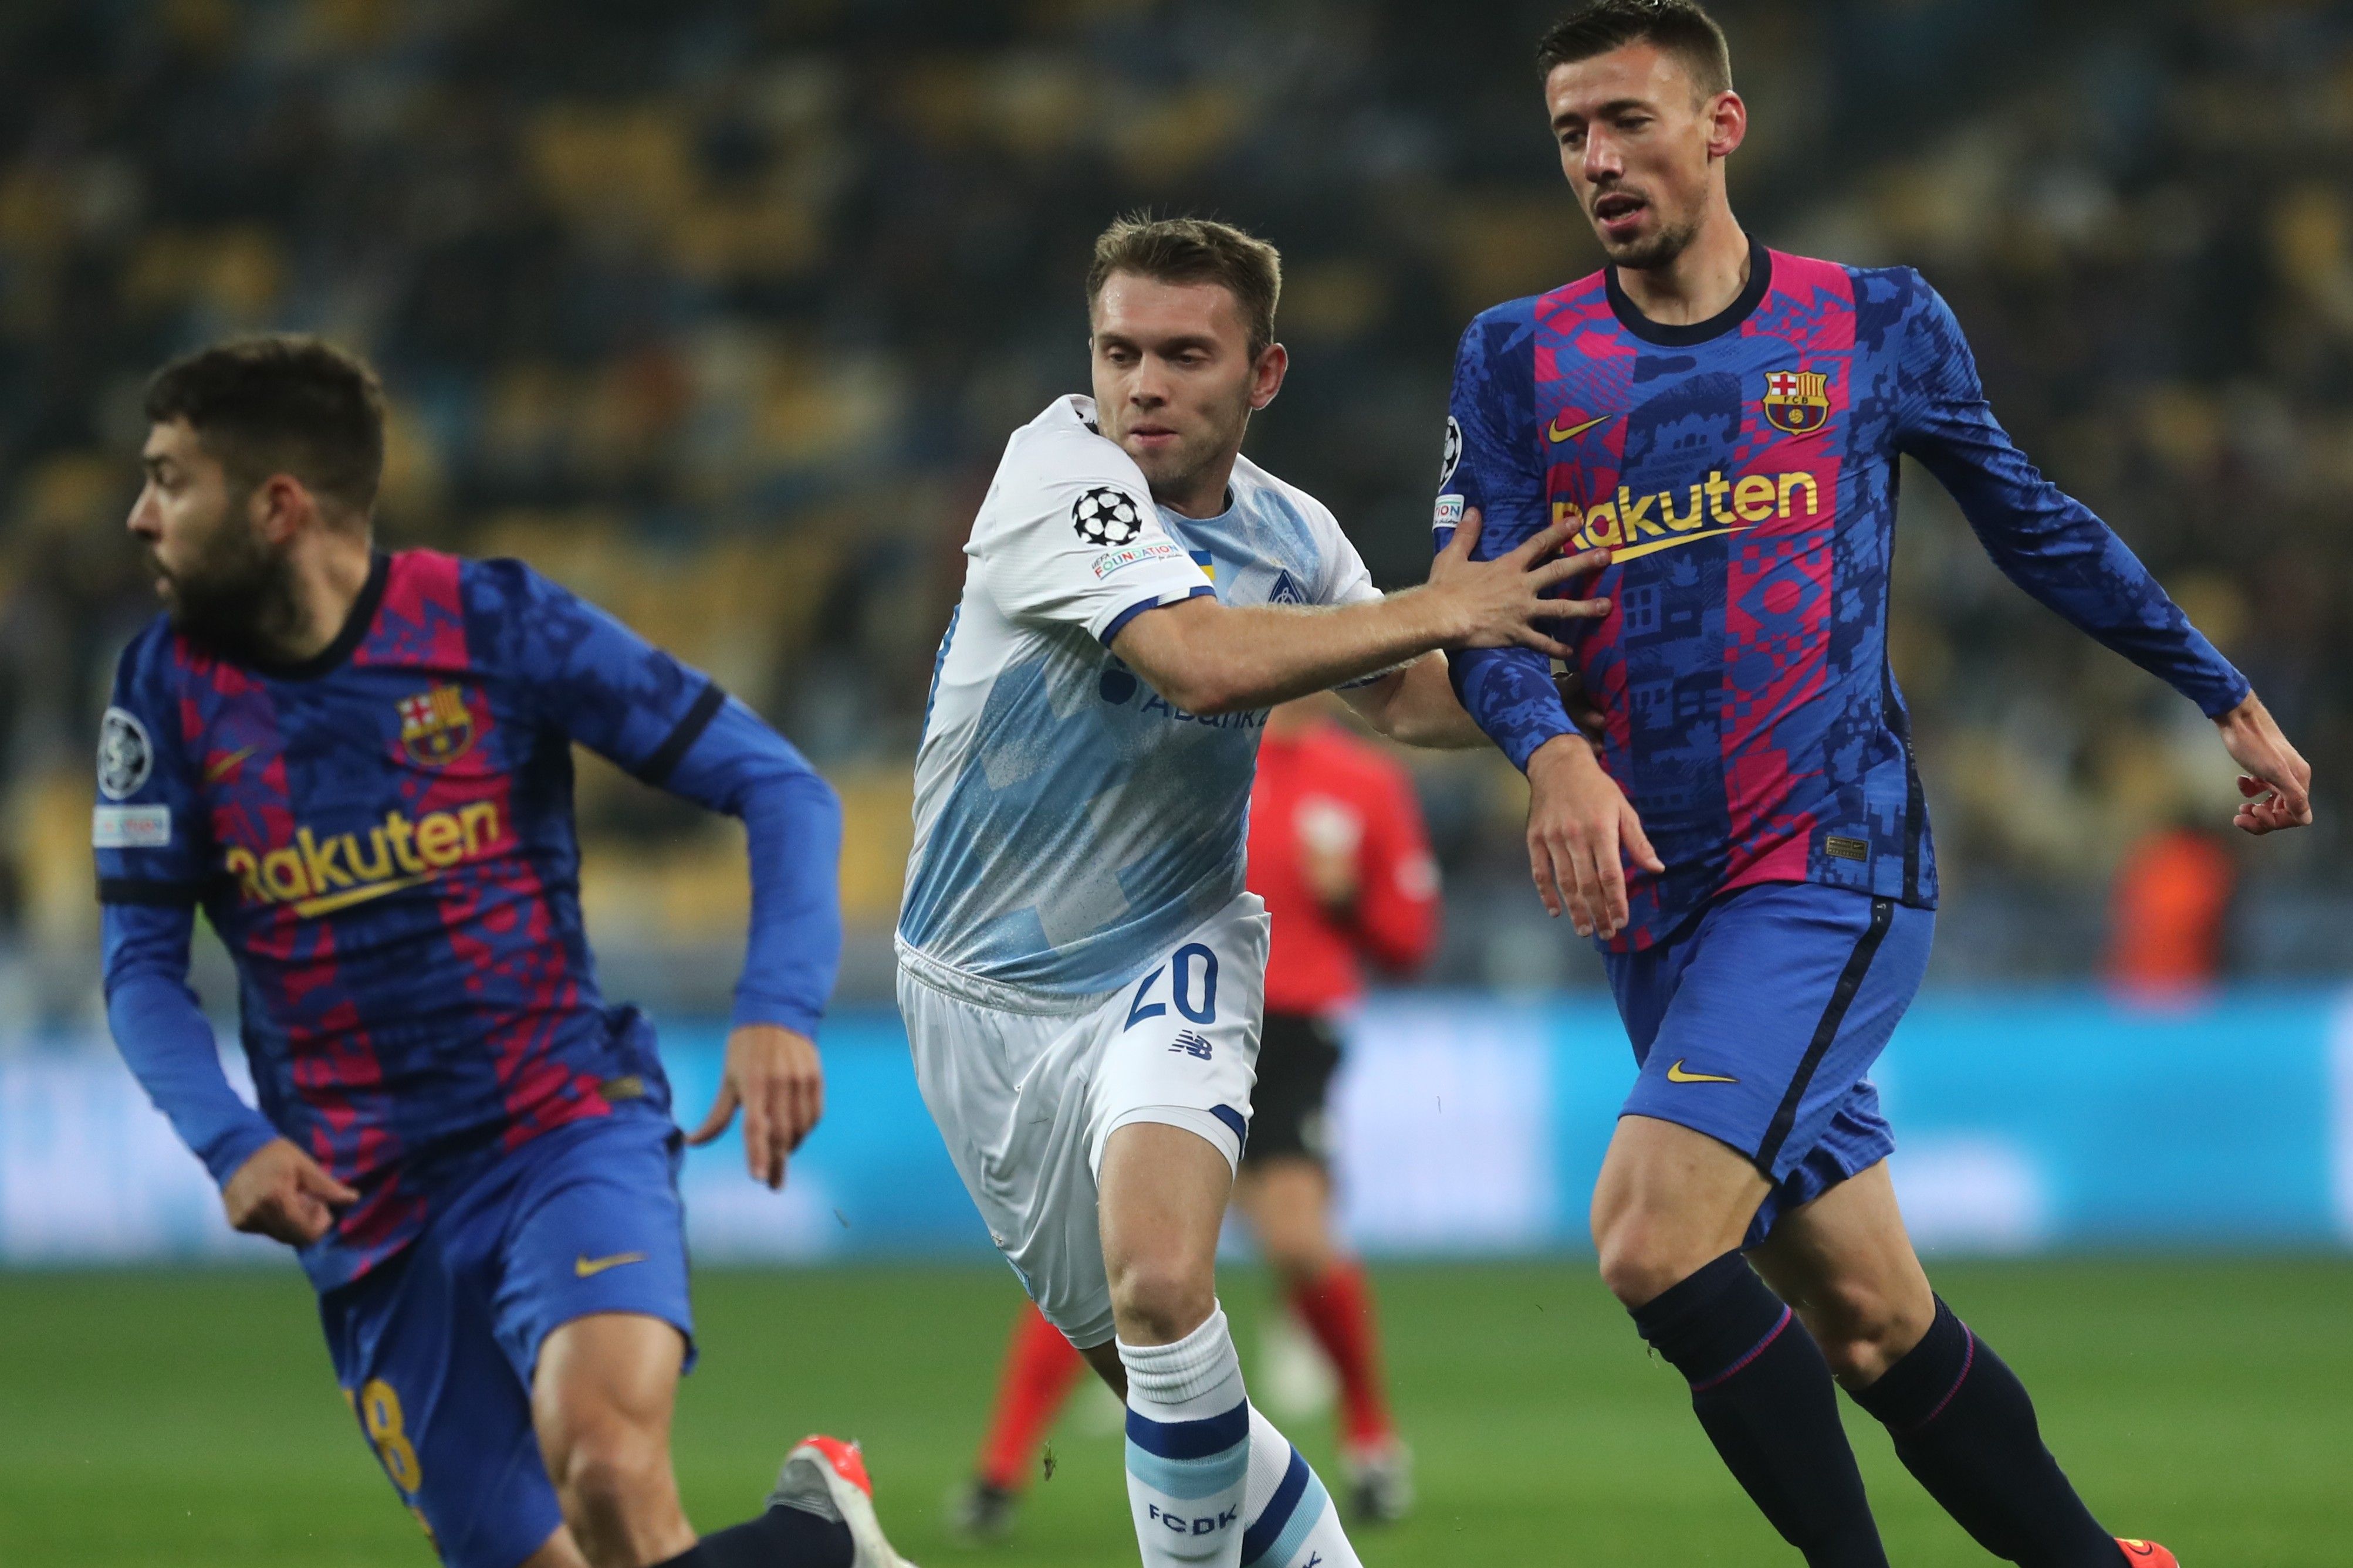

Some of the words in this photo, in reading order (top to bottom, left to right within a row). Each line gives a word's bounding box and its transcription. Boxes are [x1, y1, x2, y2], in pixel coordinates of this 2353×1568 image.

[1784, 395, 1808, 404] FCB
[1553, 470, 1818, 554] Rakuten
[1094, 544, 1178, 578] FOUNDATION
[225, 800, 499, 905] Rakuten
[1123, 943, 1219, 1034] 20
[343, 1378, 423, 1495] 8
[1149, 1503, 1237, 1536] FCDK
